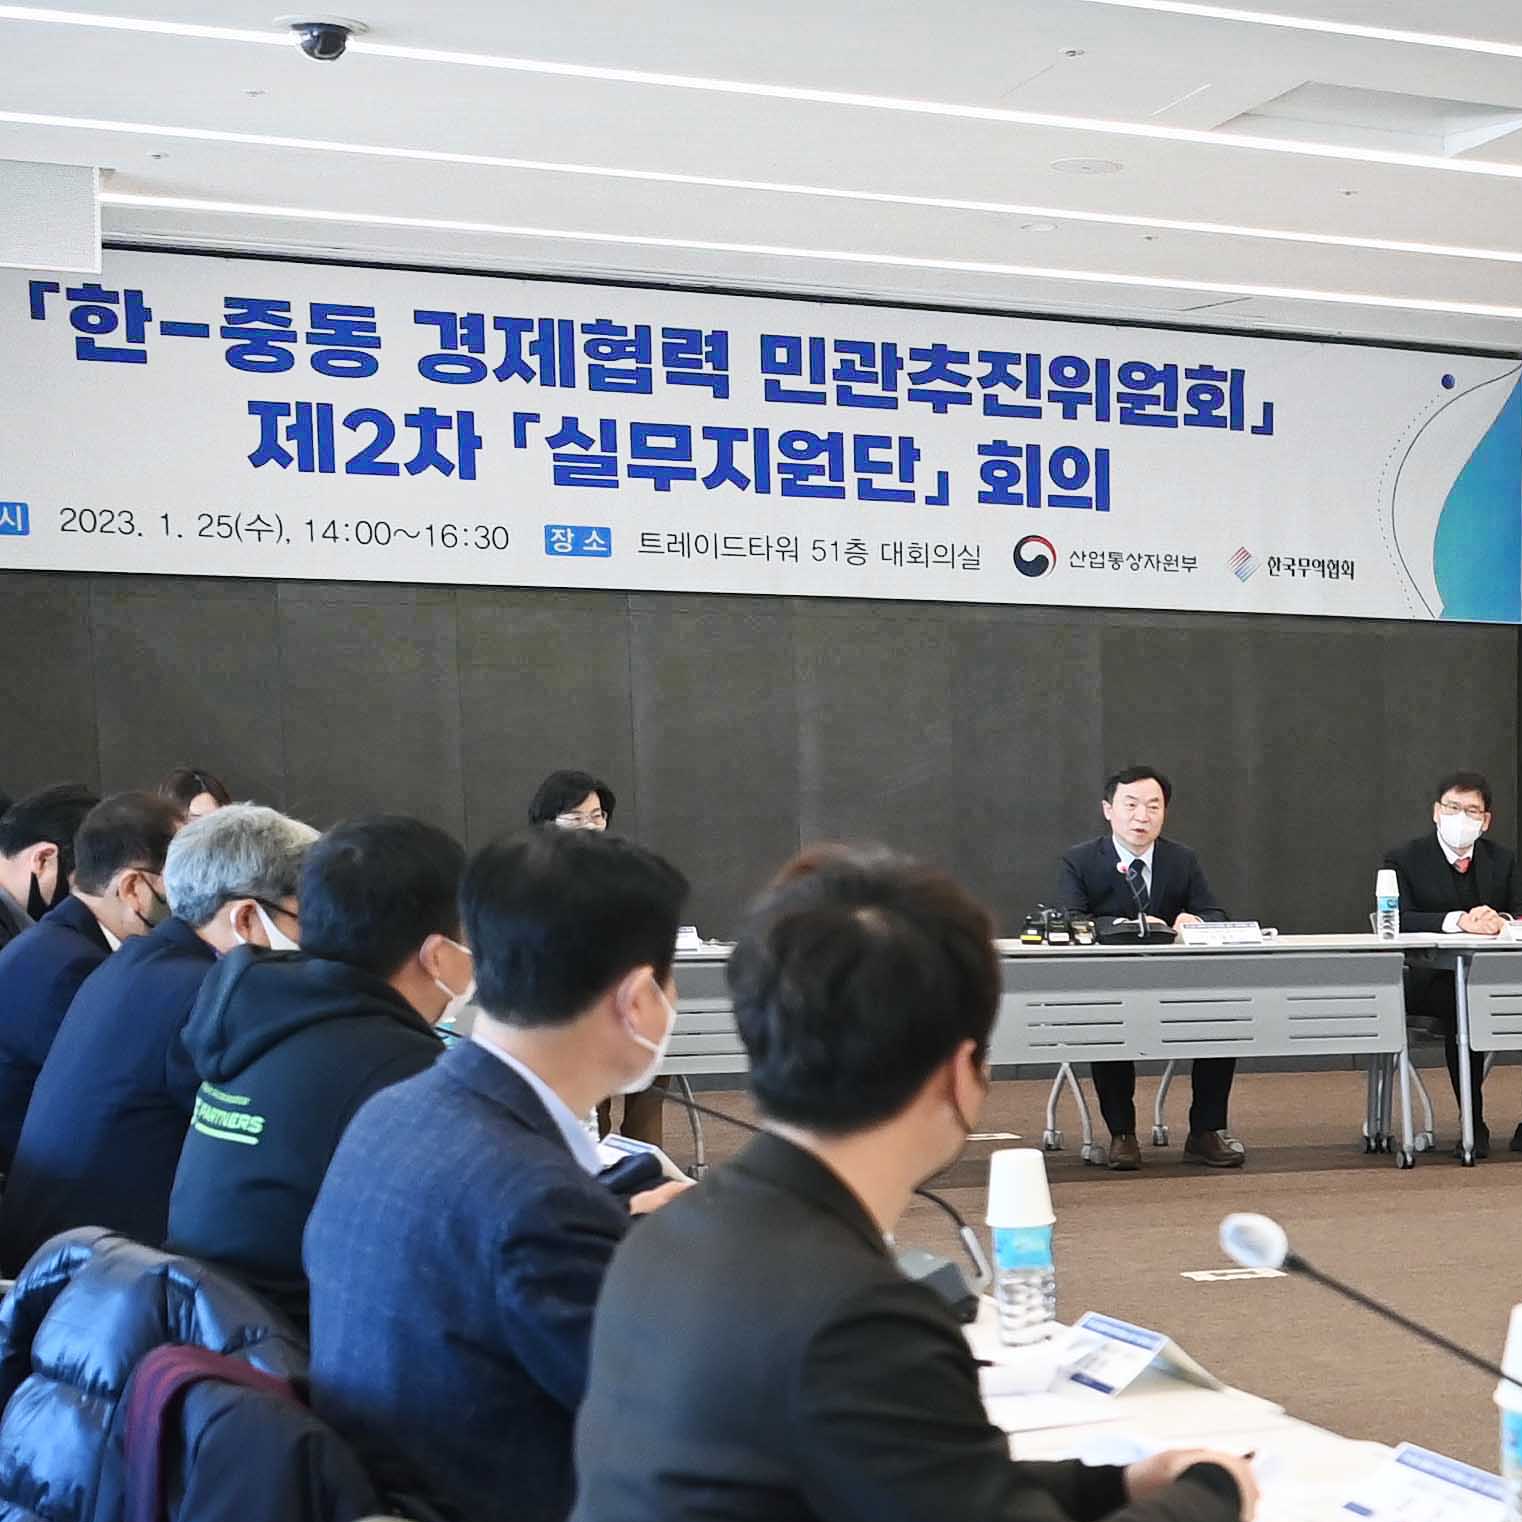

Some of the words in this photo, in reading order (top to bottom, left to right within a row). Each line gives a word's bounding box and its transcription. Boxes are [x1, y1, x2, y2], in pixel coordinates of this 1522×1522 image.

[414, 310, 730, 400] 경제협력
[760, 334, 1275, 436] 민관추진위원회」
[247, 400, 483, 481] 제2차
[512, 411, 949, 506] 「실무지원단」
[977, 439, 1110, 511] 회의
[59, 507, 143, 537] 2023.
[160, 512, 183, 539] 1.
[197, 513, 291, 545] 25(수),
[305, 519, 509, 550] 14:00~16:30
[637, 531, 799, 563] 트레이드타워
[812, 538, 869, 566] 51층
[881, 541, 981, 571] 대회의실
[1069, 550, 1199, 574] 산업통상자원부
[1267, 555, 1355, 581] 한국무역협회
